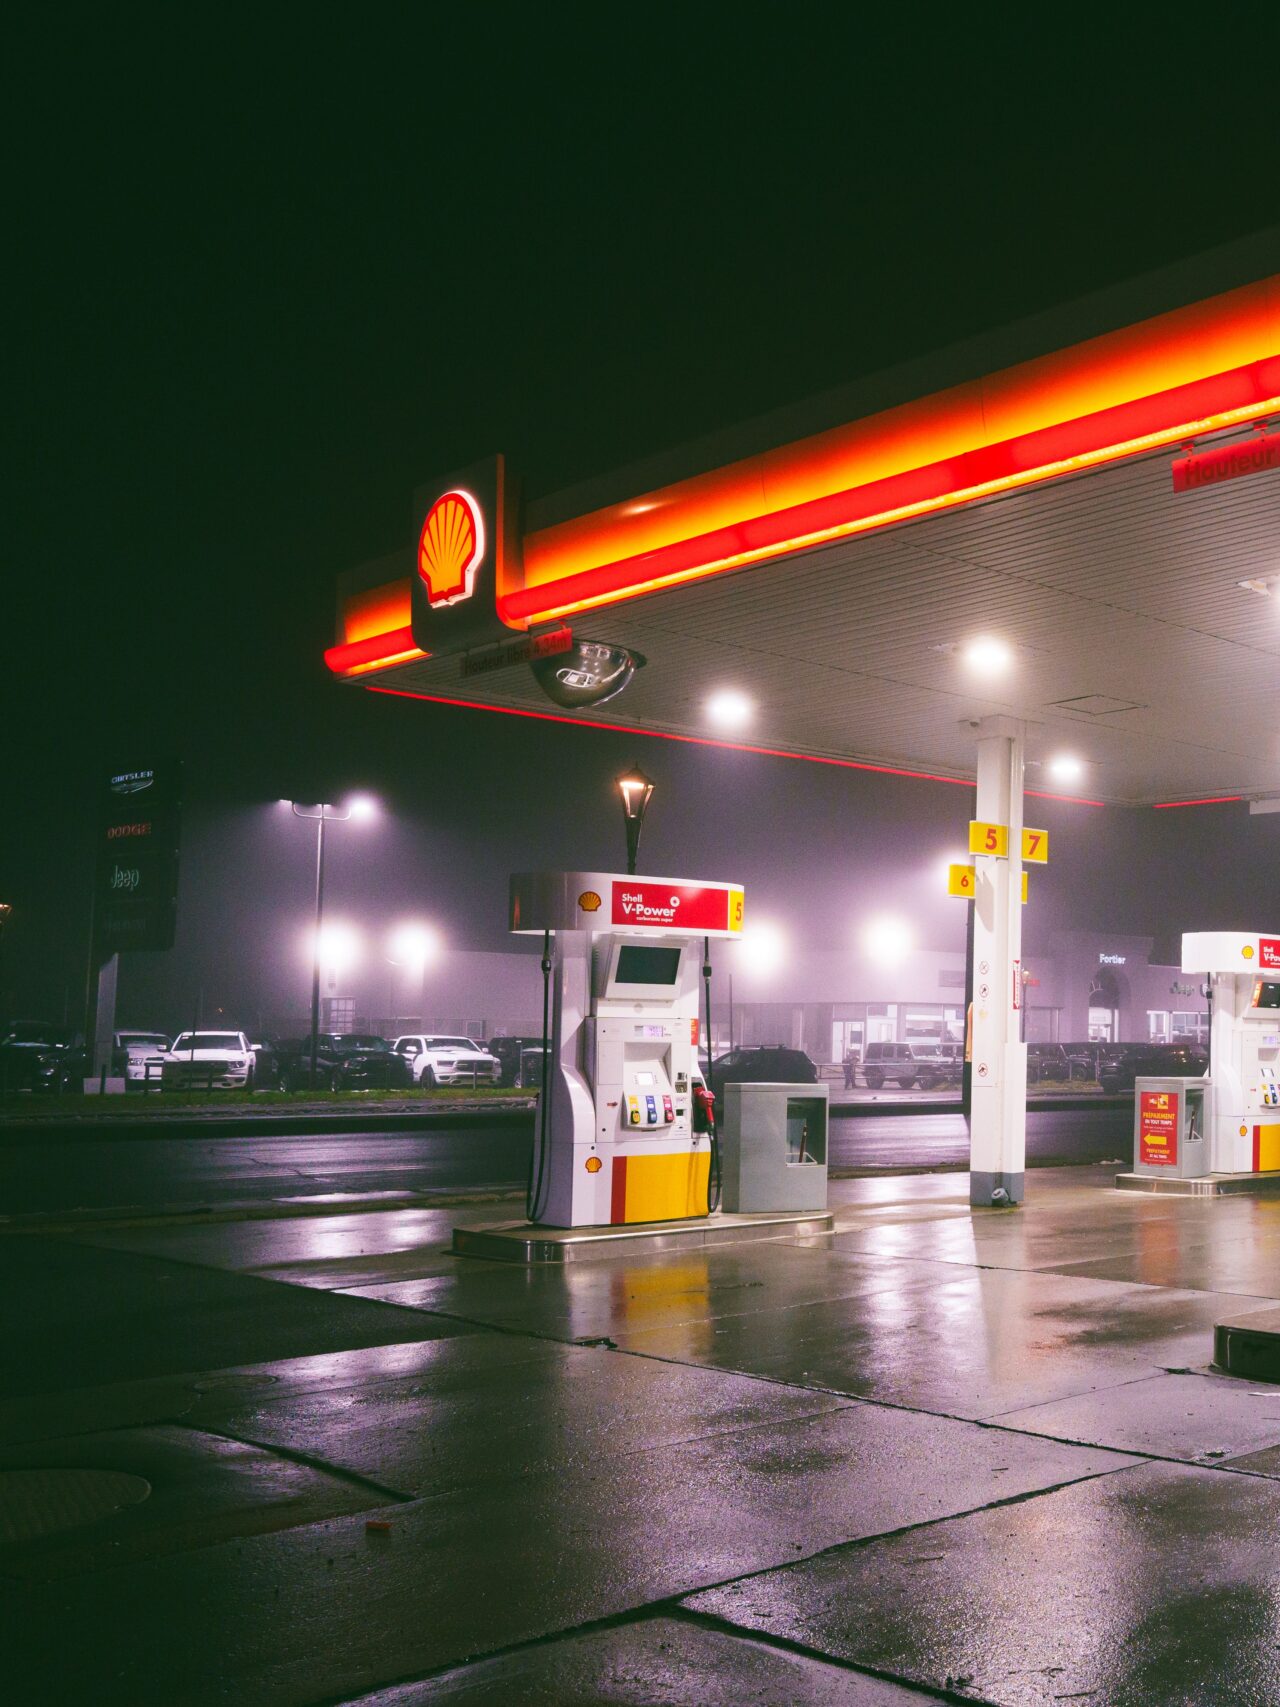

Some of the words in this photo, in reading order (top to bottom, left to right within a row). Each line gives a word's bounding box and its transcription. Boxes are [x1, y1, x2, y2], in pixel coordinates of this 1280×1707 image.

[1184, 449, 1275, 486] Hauteur
[107, 823, 151, 840] DODGE
[985, 828, 998, 850] 5
[1028, 834, 1041, 856] 7
[111, 865, 140, 891] Jeep
[961, 875, 969, 888] 6
[621, 893, 643, 903] Shell
[622, 903, 676, 917] V-Power
[735, 902, 742, 922] 5
